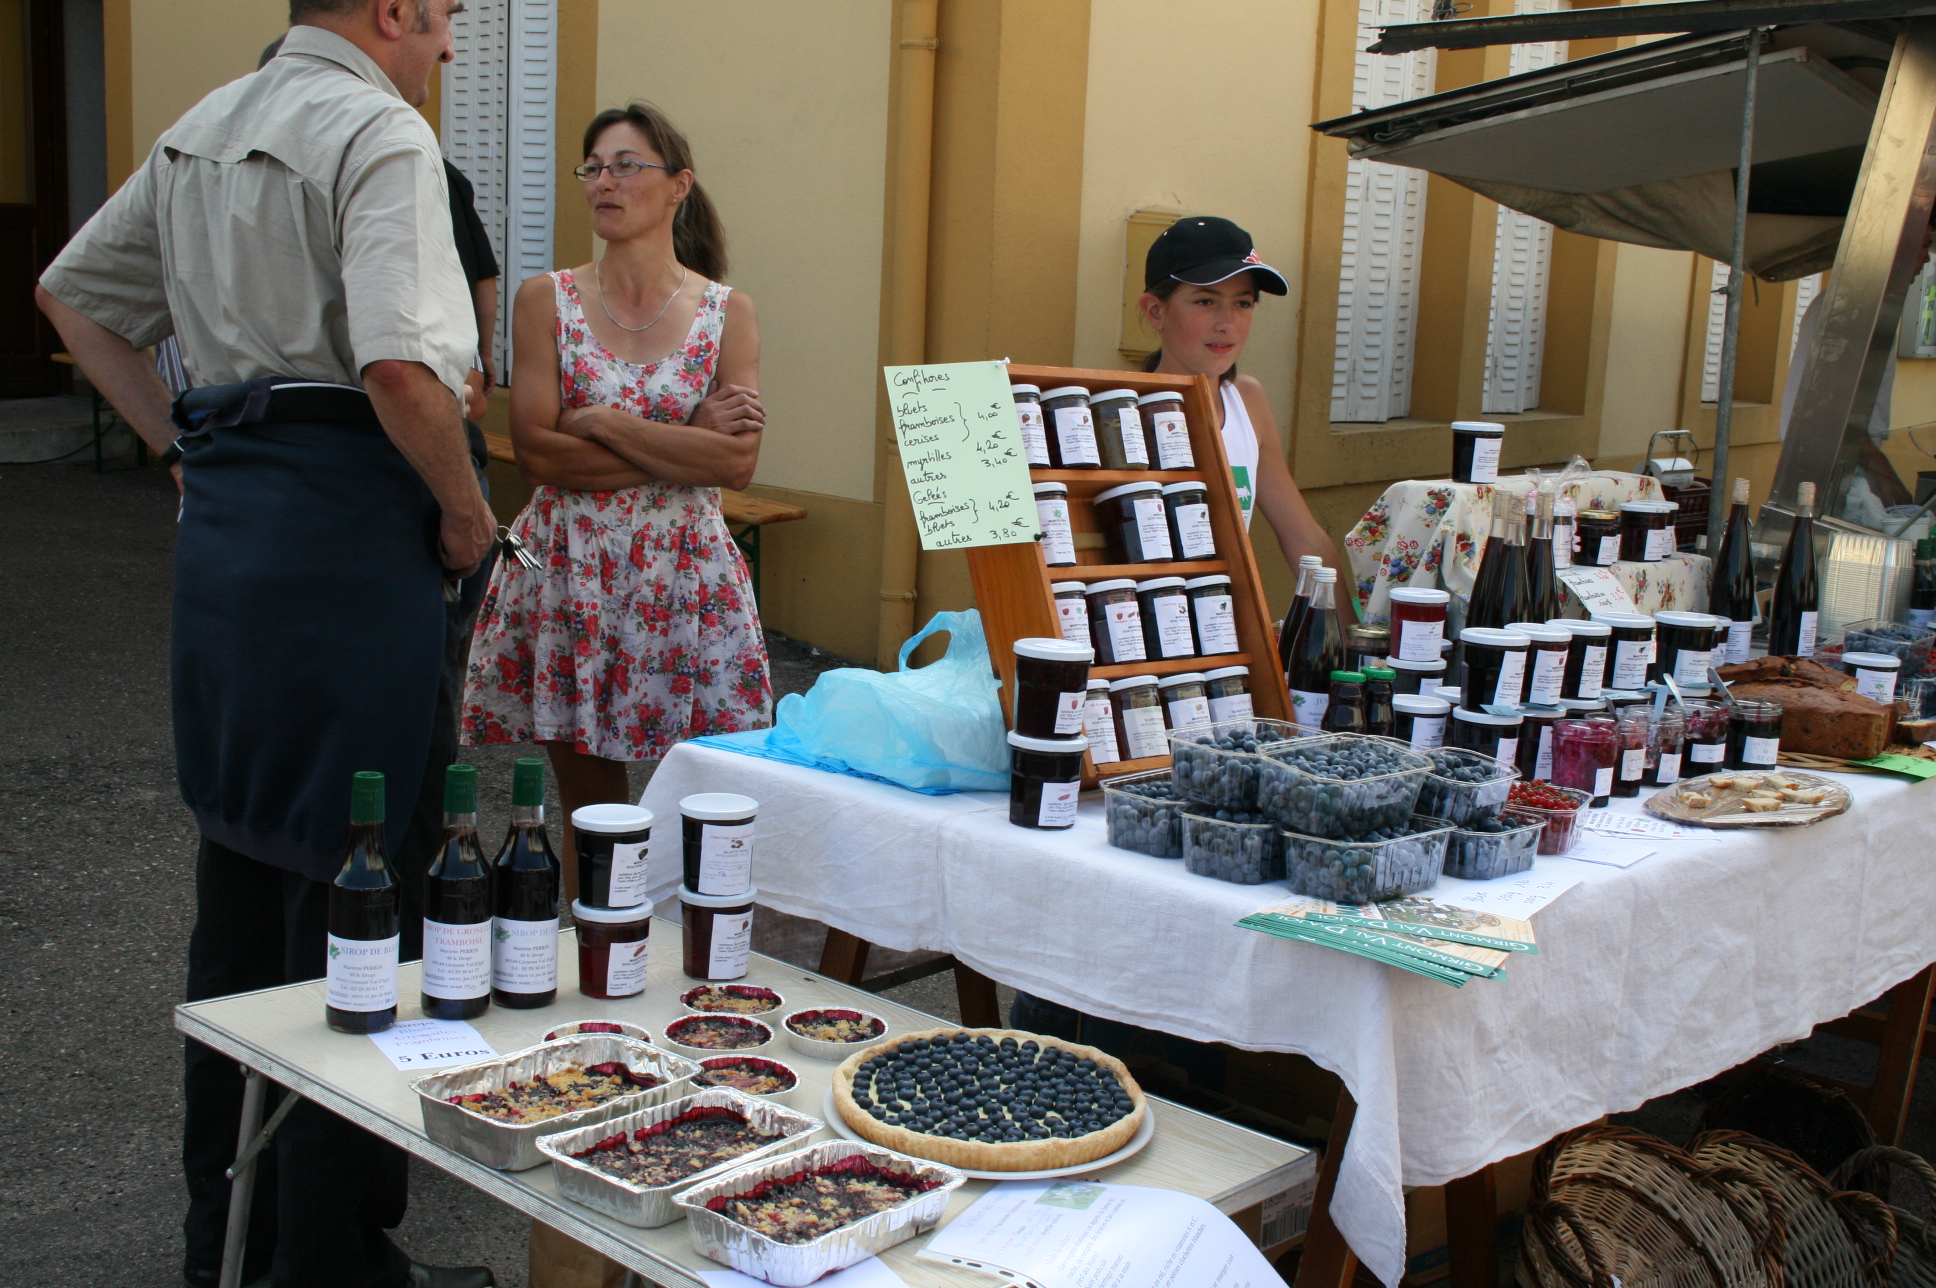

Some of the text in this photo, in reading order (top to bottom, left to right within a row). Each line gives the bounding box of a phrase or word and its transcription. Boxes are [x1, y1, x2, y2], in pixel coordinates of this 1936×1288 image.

[898, 414, 955, 439] framboises
[904, 434, 939, 447] cerises
[907, 450, 952, 471] myrtilles
[910, 470, 947, 484] autres
[919, 501, 970, 528] framboises
[936, 533, 972, 548] autres
[1275, 914, 1348, 934] D'AJOL
[1312, 913, 1529, 951] GIRMONT VAL D'AJOL
[511, 929, 538, 937] SIROP
[1354, 930, 1387, 946] VAL
[435, 937, 484, 946] FRAMBOISE
[341, 946, 383, 956] SIROP DE
[1391, 941, 1483, 972] GIRMONT
[398, 1049, 490, 1063] 5 Euros
[1164, 1259, 1173, 1271] riche
[1176, 1232, 1189, 1252] vitamines
[1094, 1260, 1107, 1281] pesticide
[1122, 1262, 1131, 1274] main
